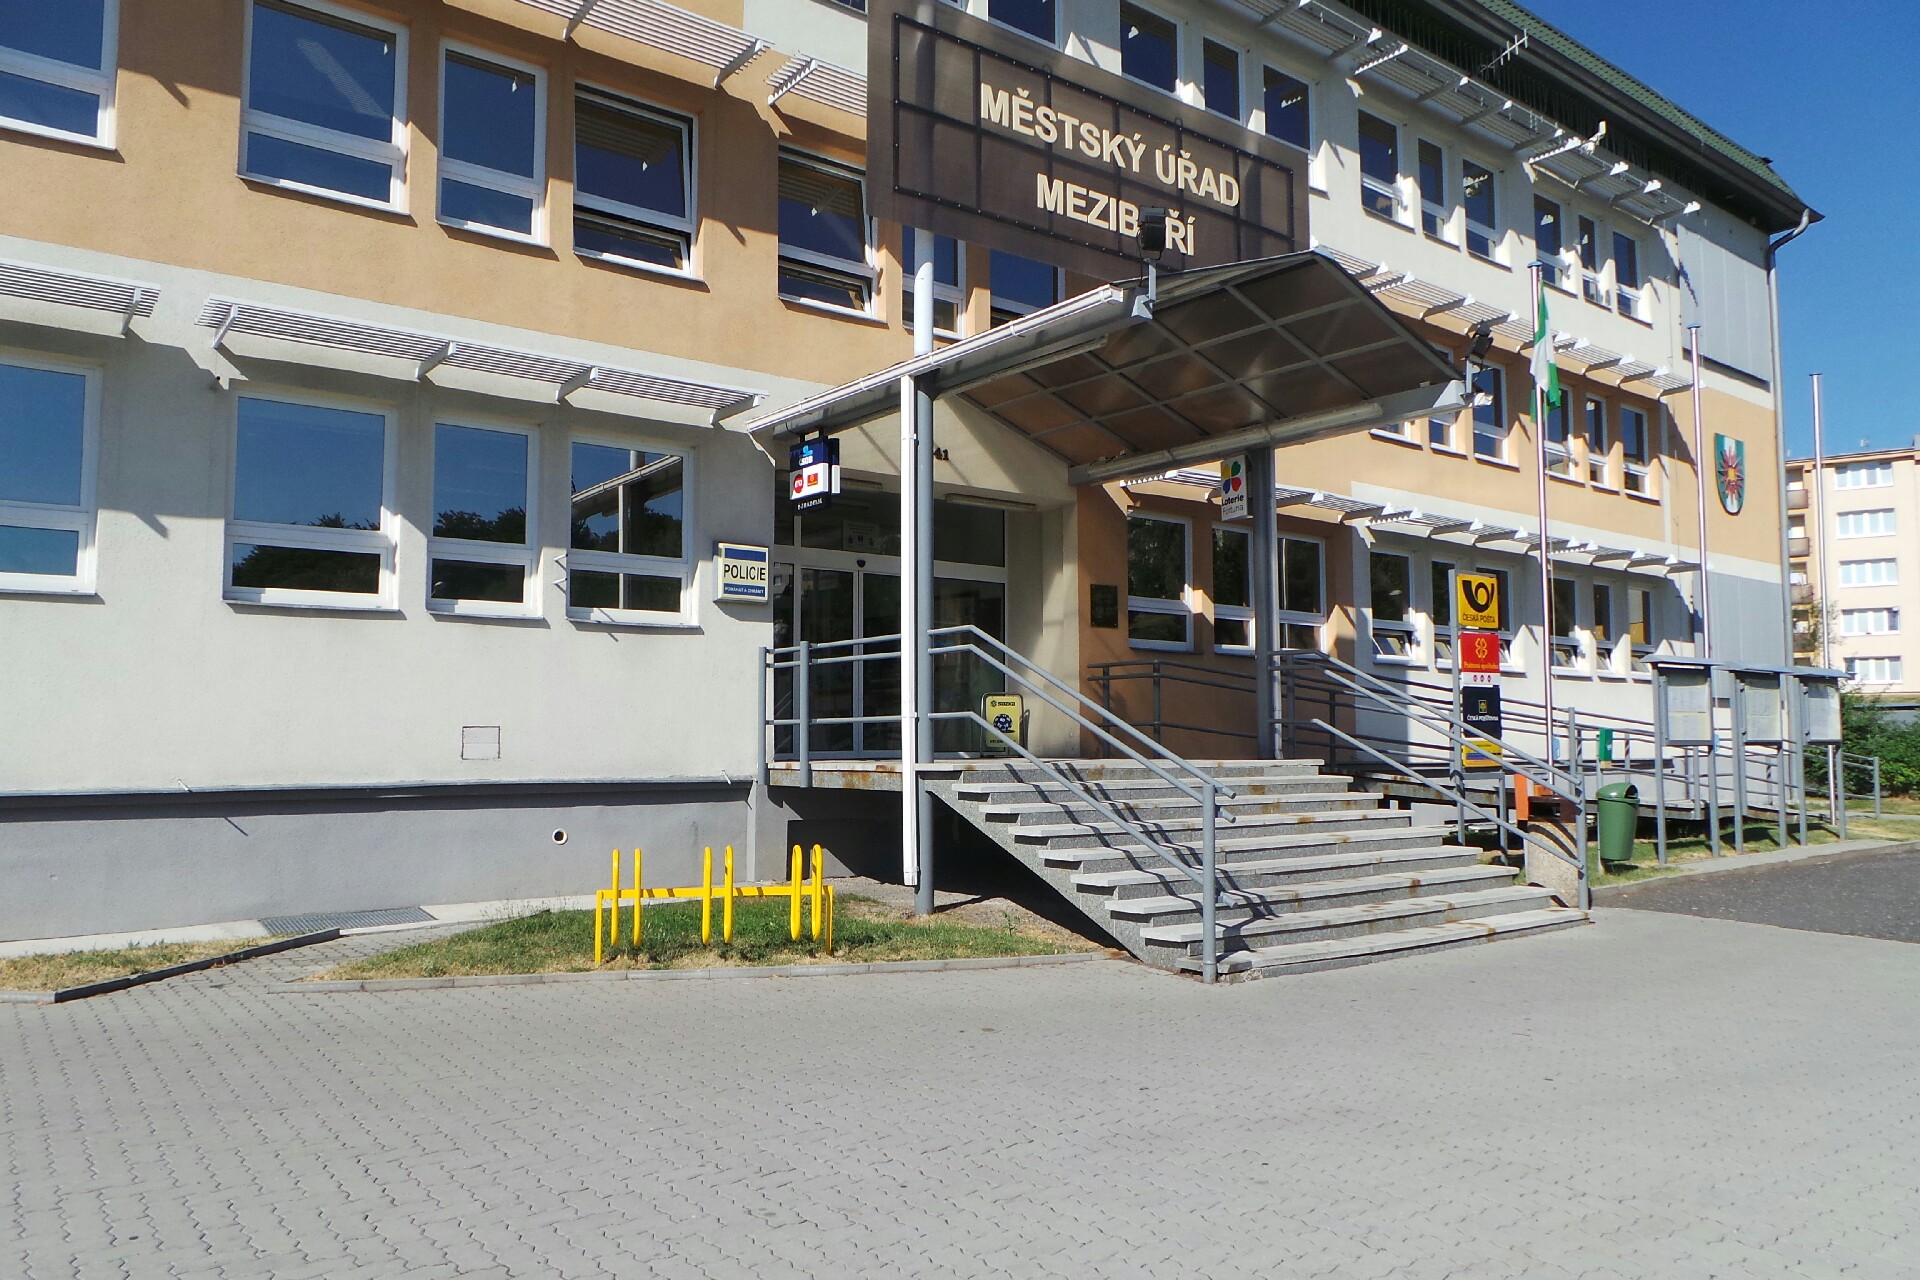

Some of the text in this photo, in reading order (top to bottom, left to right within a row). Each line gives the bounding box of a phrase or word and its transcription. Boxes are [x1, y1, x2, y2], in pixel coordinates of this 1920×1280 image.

[980, 83, 1240, 207] MĚSTSKÝ ÚŘAD
[1036, 172, 1196, 257] MEZIBŘÍ
[1222, 494, 1244, 506] Loterie
[1222, 504, 1244, 515] Fortuna
[724, 564, 766, 580] POLICIE
[1463, 612, 1478, 622] ČESKÁ
